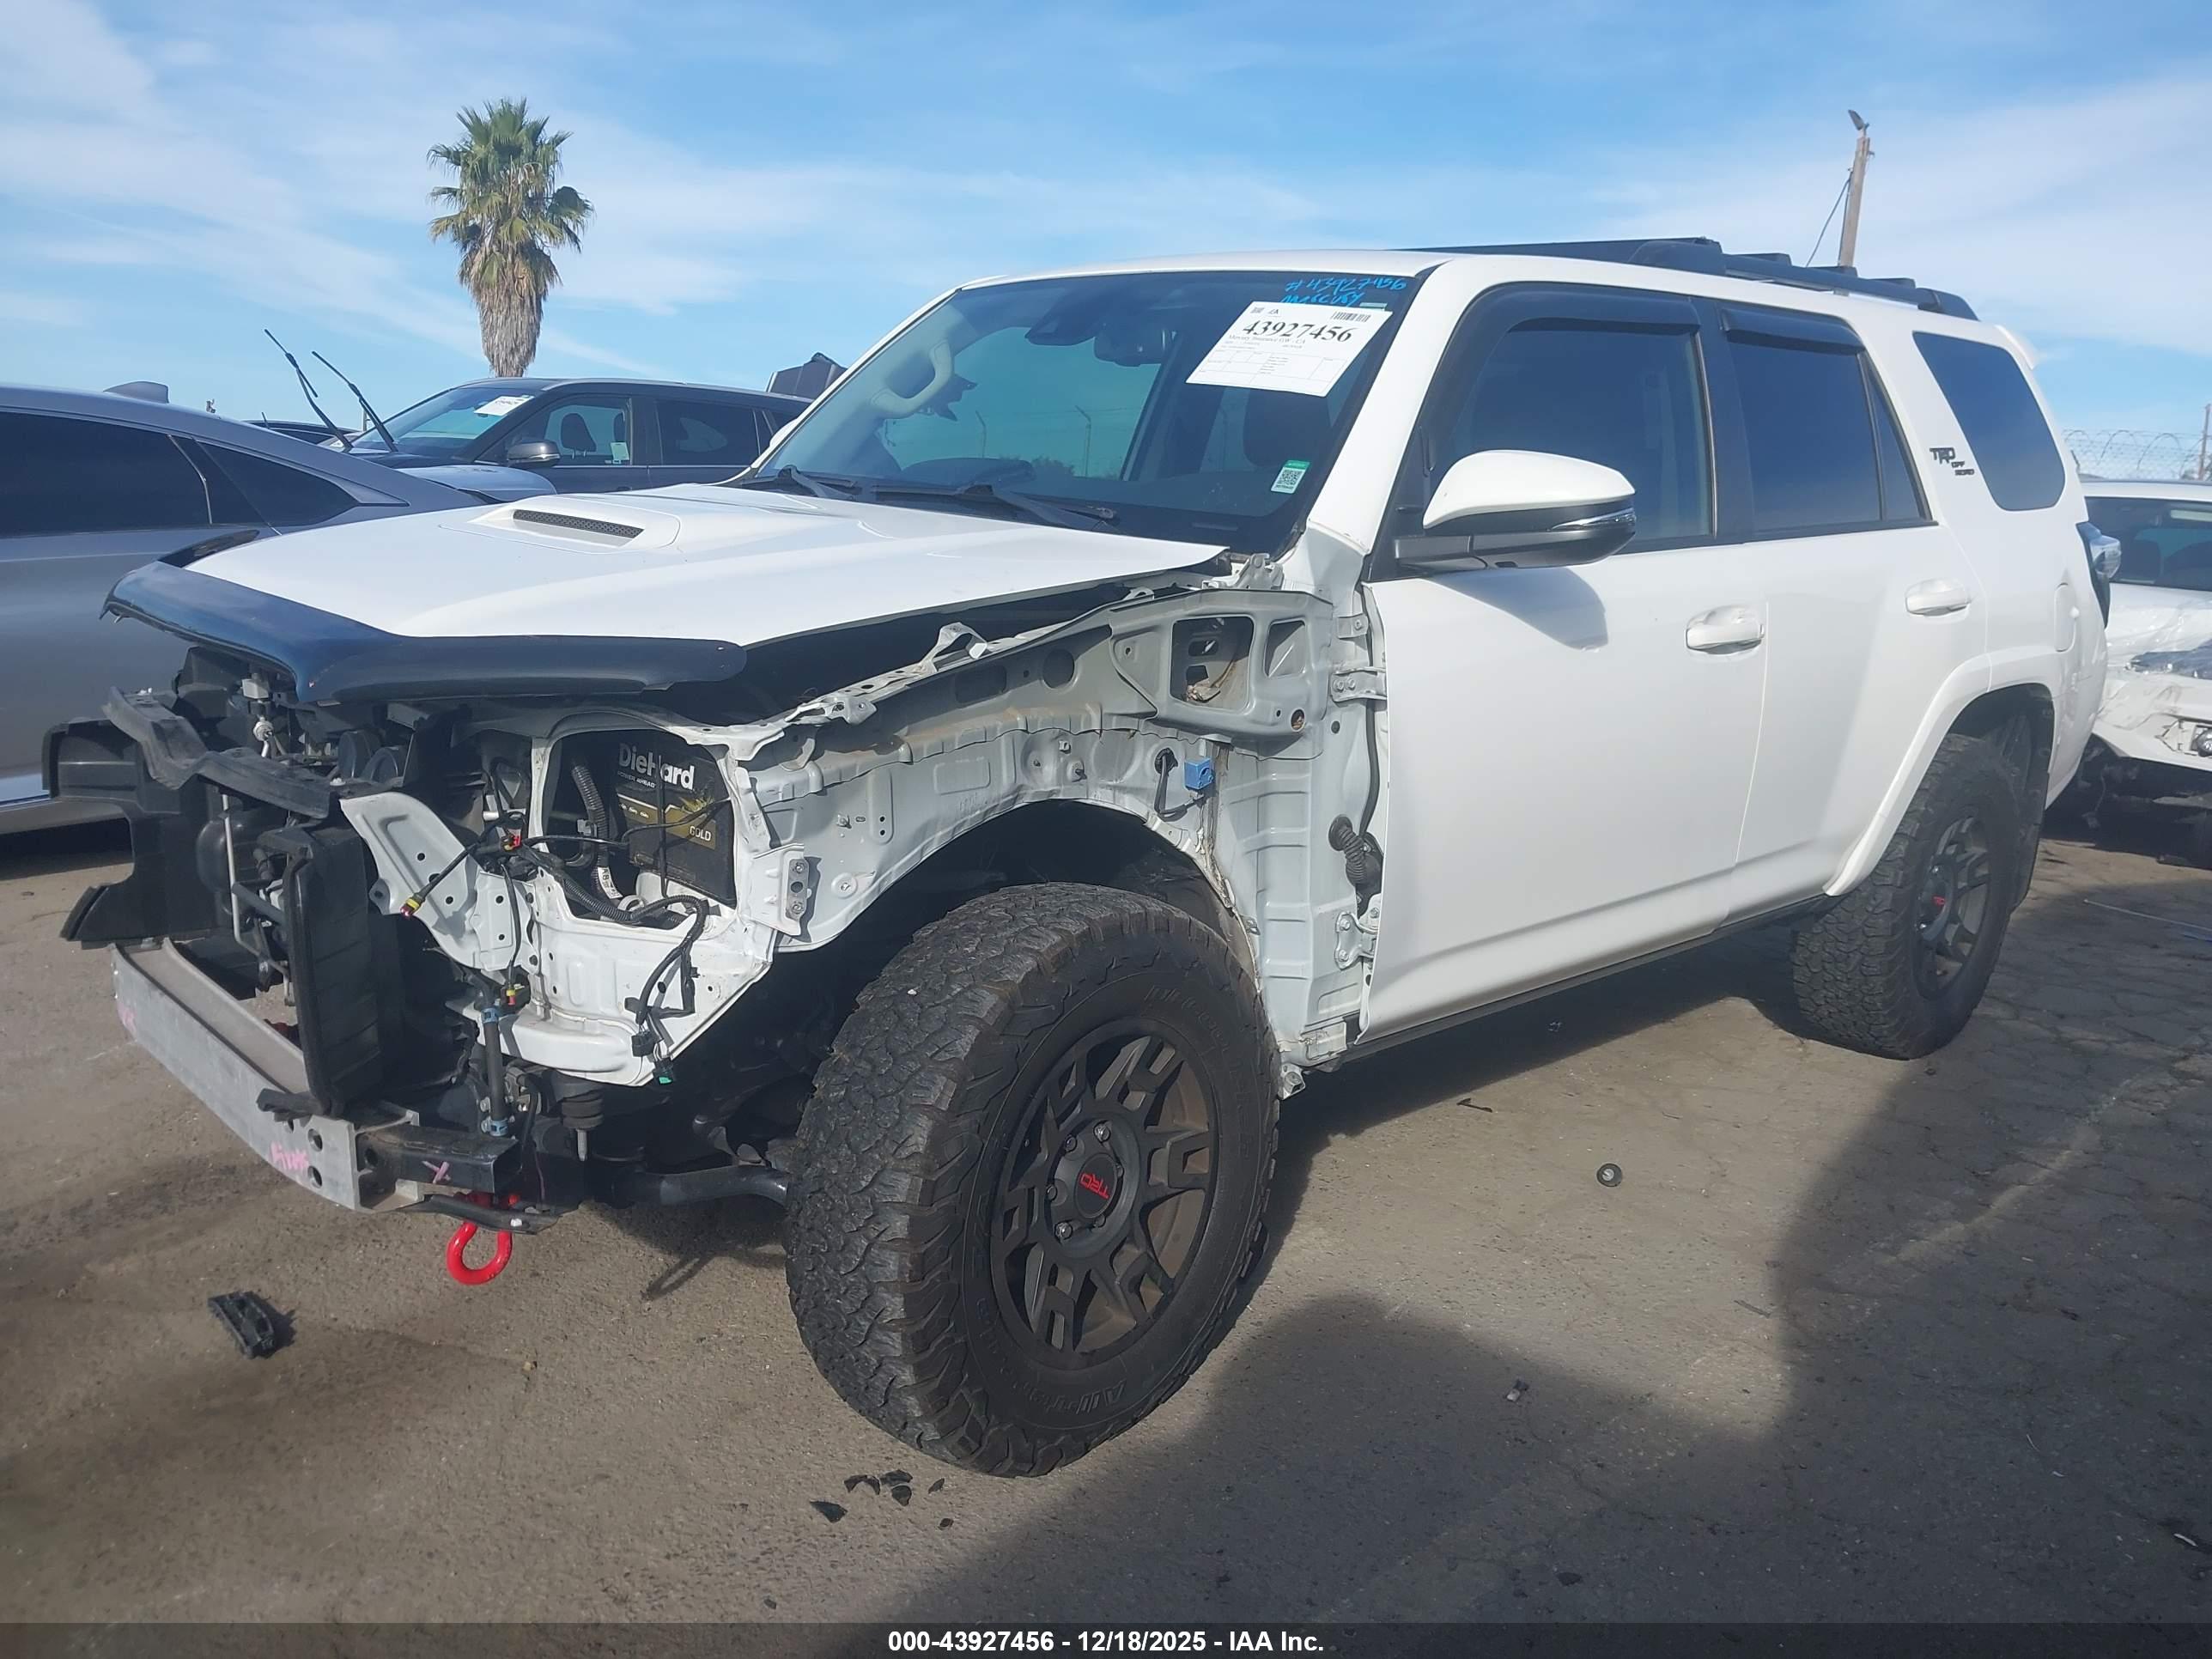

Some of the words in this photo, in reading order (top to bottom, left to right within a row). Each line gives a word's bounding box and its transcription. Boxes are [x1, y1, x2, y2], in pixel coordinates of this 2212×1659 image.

[1243, 320, 1358, 343] 43927456
[1929, 447, 1956, 465] TRD
[690, 824, 712, 842] GOLD
[1079, 1172, 1110, 1200] TRD
